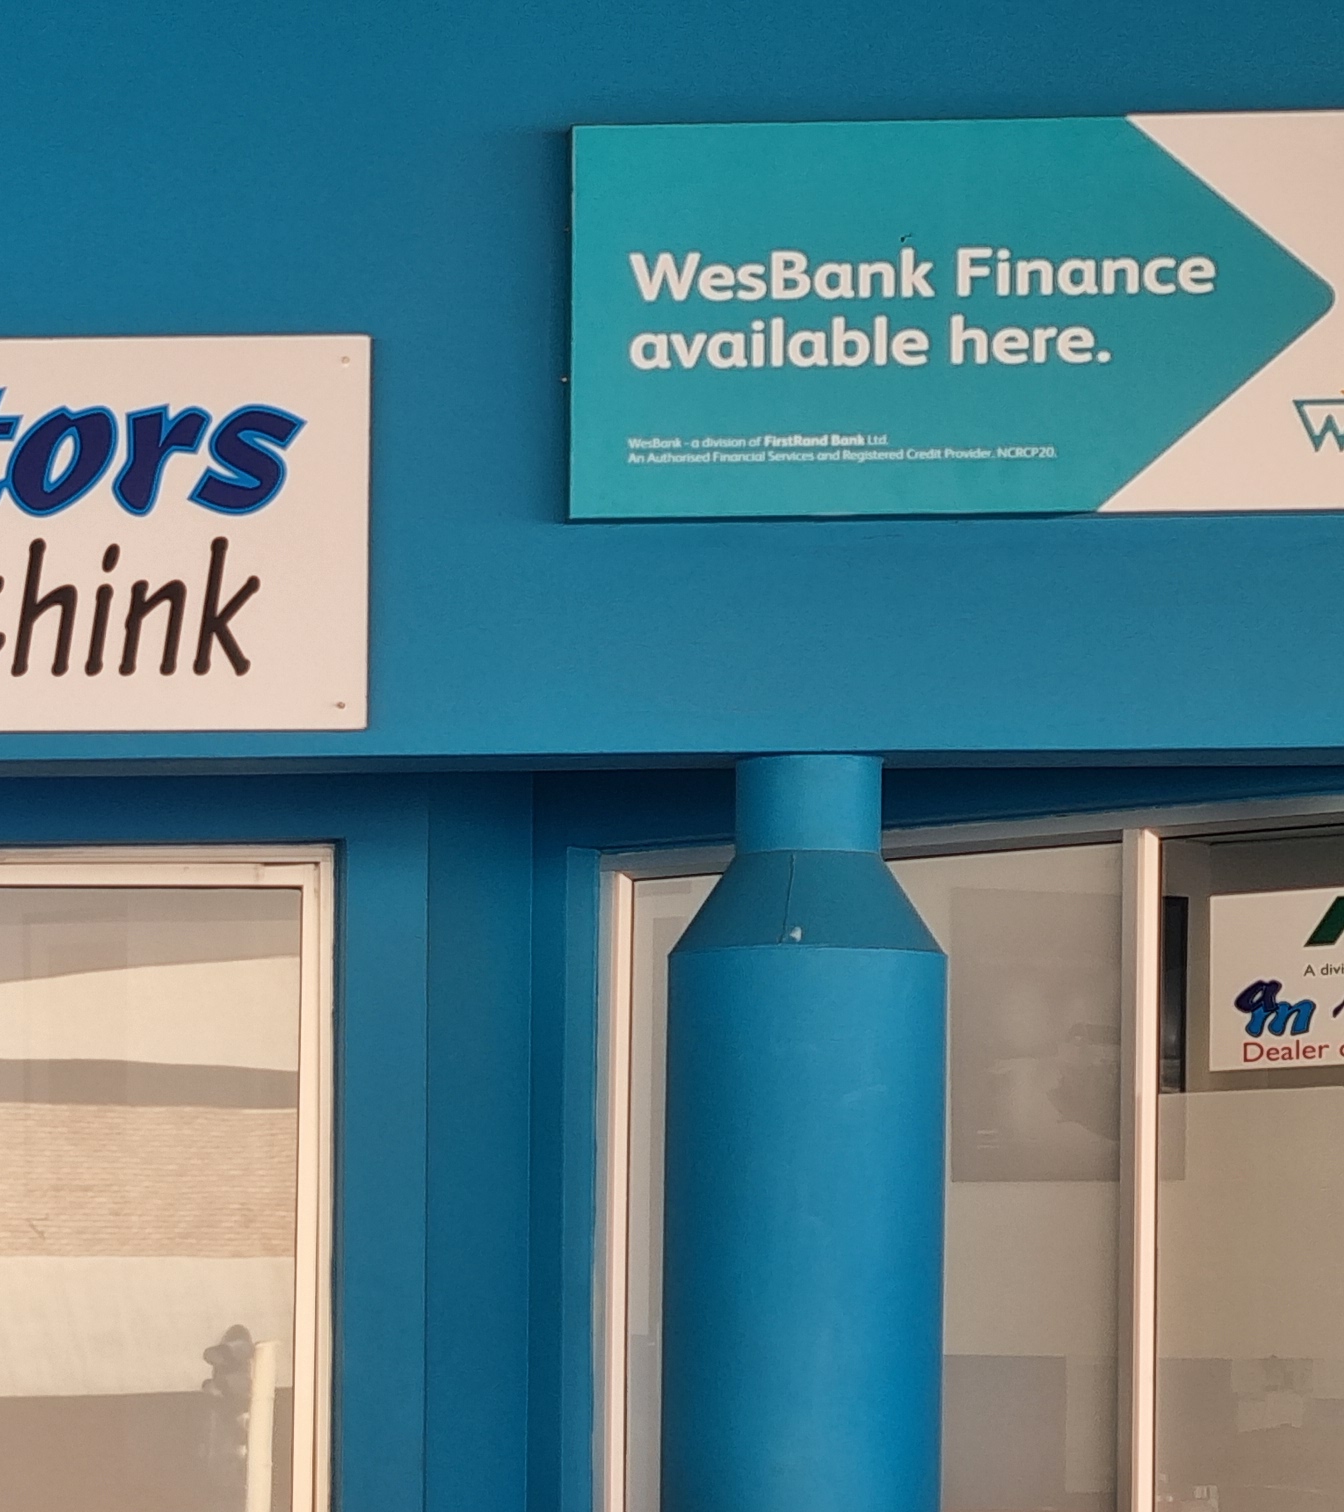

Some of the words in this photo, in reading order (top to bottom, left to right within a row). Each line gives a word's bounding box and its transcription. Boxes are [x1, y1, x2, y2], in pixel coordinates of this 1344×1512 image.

[630, 247, 934, 301] WesBank
[957, 247, 1216, 297] Finance
[629, 314, 929, 370] available
[950, 314, 1112, 365] here.
[628, 438, 681, 449] WesBank
[702, 437, 746, 448] division
[748, 436, 761, 447] of
[764, 434, 828, 447] FirstRand
[831, 434, 865, 447] Bank
[628, 453, 644, 463] An
[647, 452, 711, 463] Authorised
[713, 450, 765, 462] Financial
[767, 450, 814, 461] Services
[817, 450, 839, 460] and
[843, 449, 904, 463] Registered
[906, 448, 942, 460] Credit
[1242, 1040, 1330, 1062] Dealer
